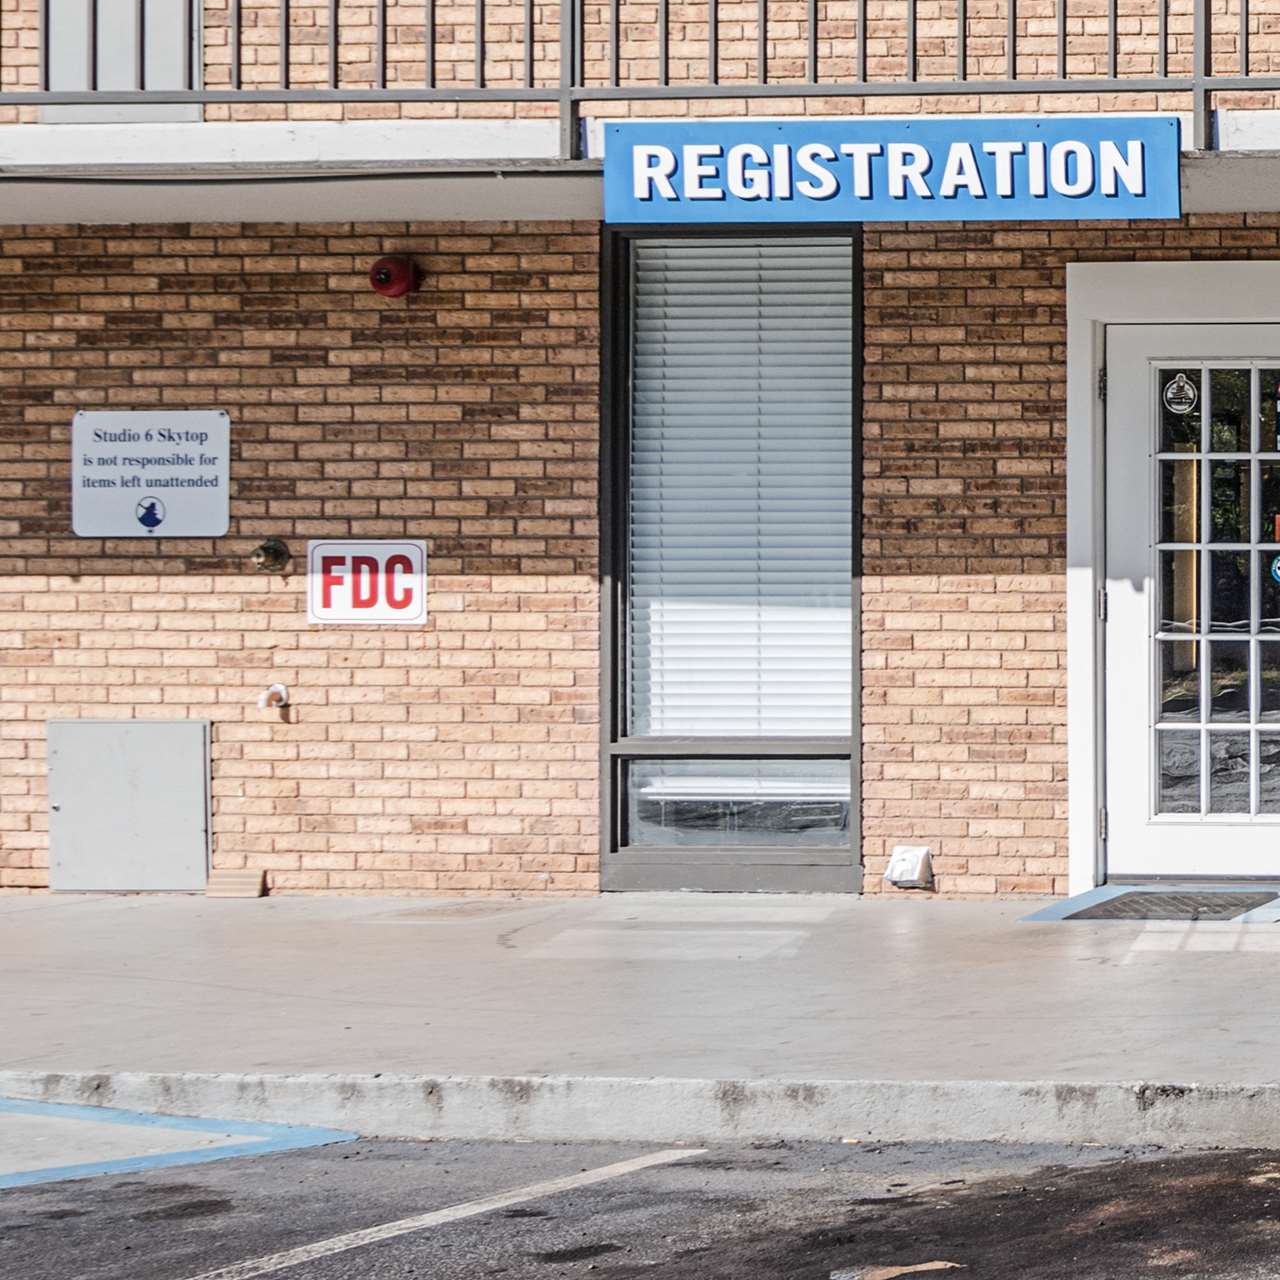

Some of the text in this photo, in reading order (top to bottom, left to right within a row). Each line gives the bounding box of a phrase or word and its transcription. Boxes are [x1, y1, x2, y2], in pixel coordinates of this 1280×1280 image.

[631, 139, 1146, 201] REGISTRATION
[92, 428, 209, 446] Studio 6 Skytop
[83, 453, 219, 469] is not responsible for
[82, 475, 219, 488] items left unattended
[320, 554, 415, 610] FDC
